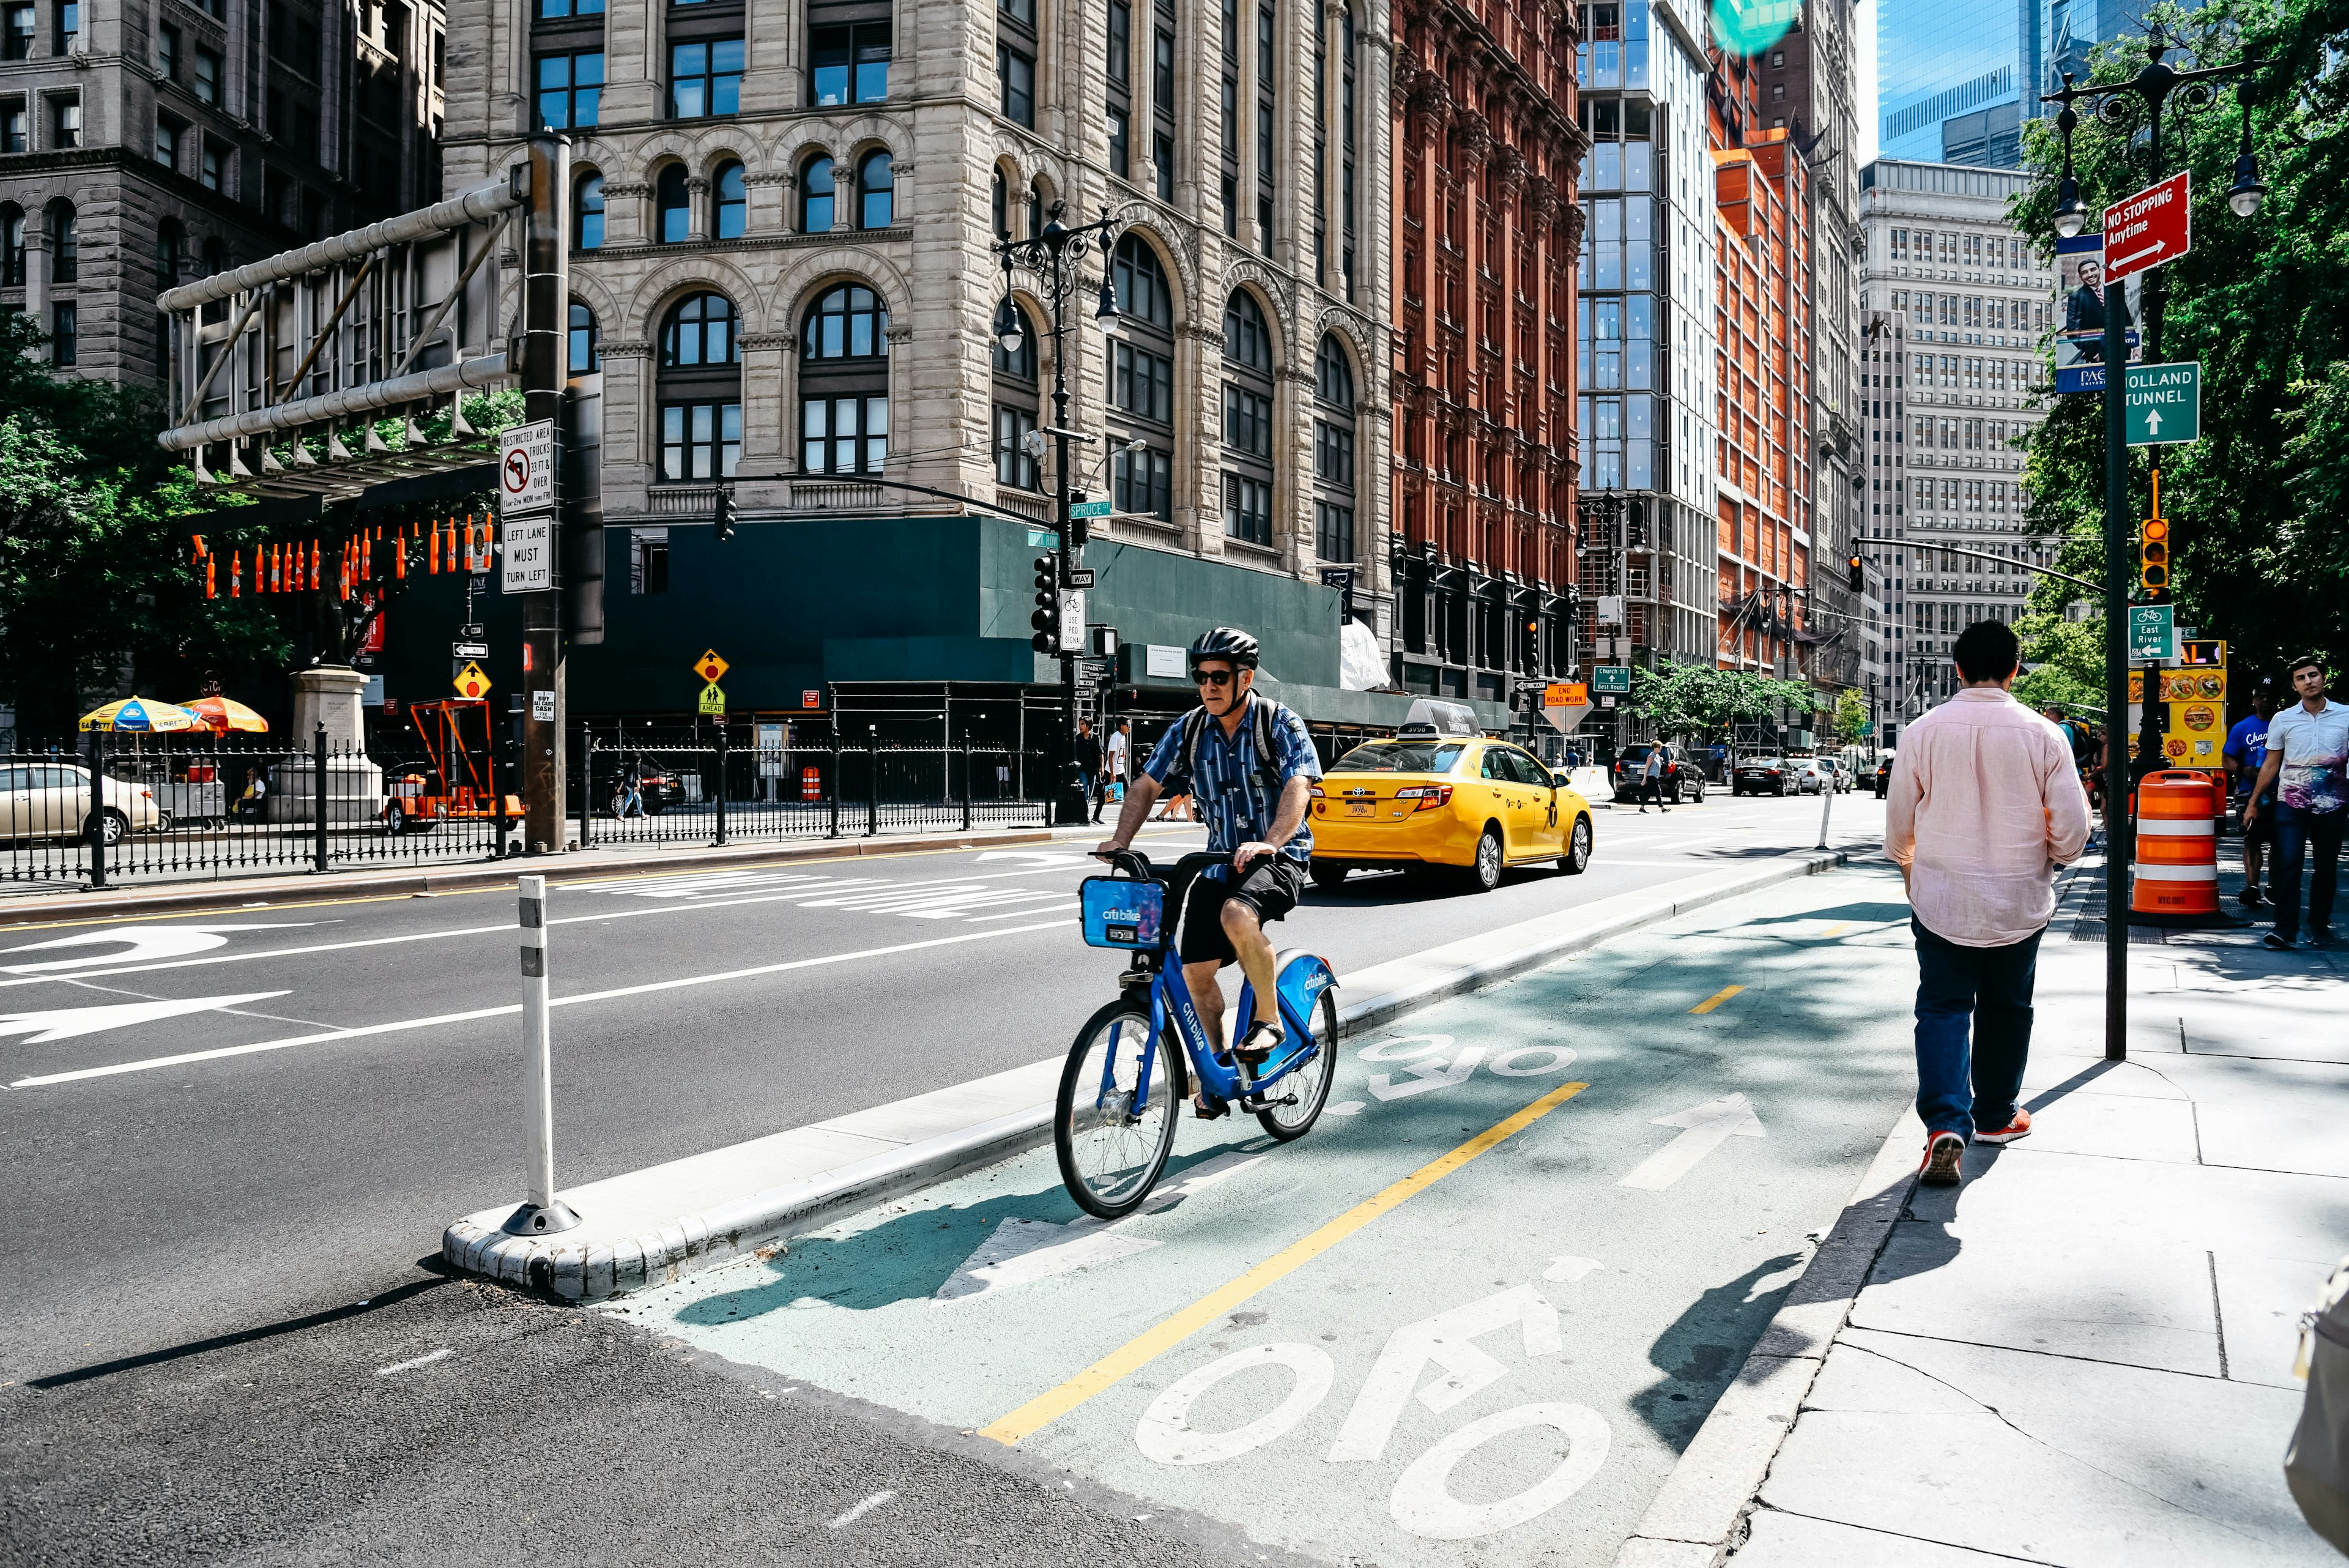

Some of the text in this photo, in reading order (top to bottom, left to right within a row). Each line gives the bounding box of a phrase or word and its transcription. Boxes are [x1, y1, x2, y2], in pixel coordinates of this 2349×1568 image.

[2108, 188, 2172, 229] NO STOPPING
[2108, 220, 2148, 247] Anytime
[2126, 390, 2186, 406] TUNNEL
[503, 427, 549, 447] RESTRICTED AREA
[530, 443, 550, 457] TRUCKS
[531, 459, 549, 473] 33 FT &
[533, 476, 547, 488] OVER
[523, 495, 533, 503] MON
[1071, 504, 1102, 517] SPRUCE
[507, 527, 546, 541] LEFT LANE
[1046, 535, 1058, 546] ROW
[514, 548, 538, 562] MUST
[507, 570, 546, 582] TURN LEFT
[2141, 625, 2158, 634] East
[1065, 636, 1082, 645] SIGNAL
